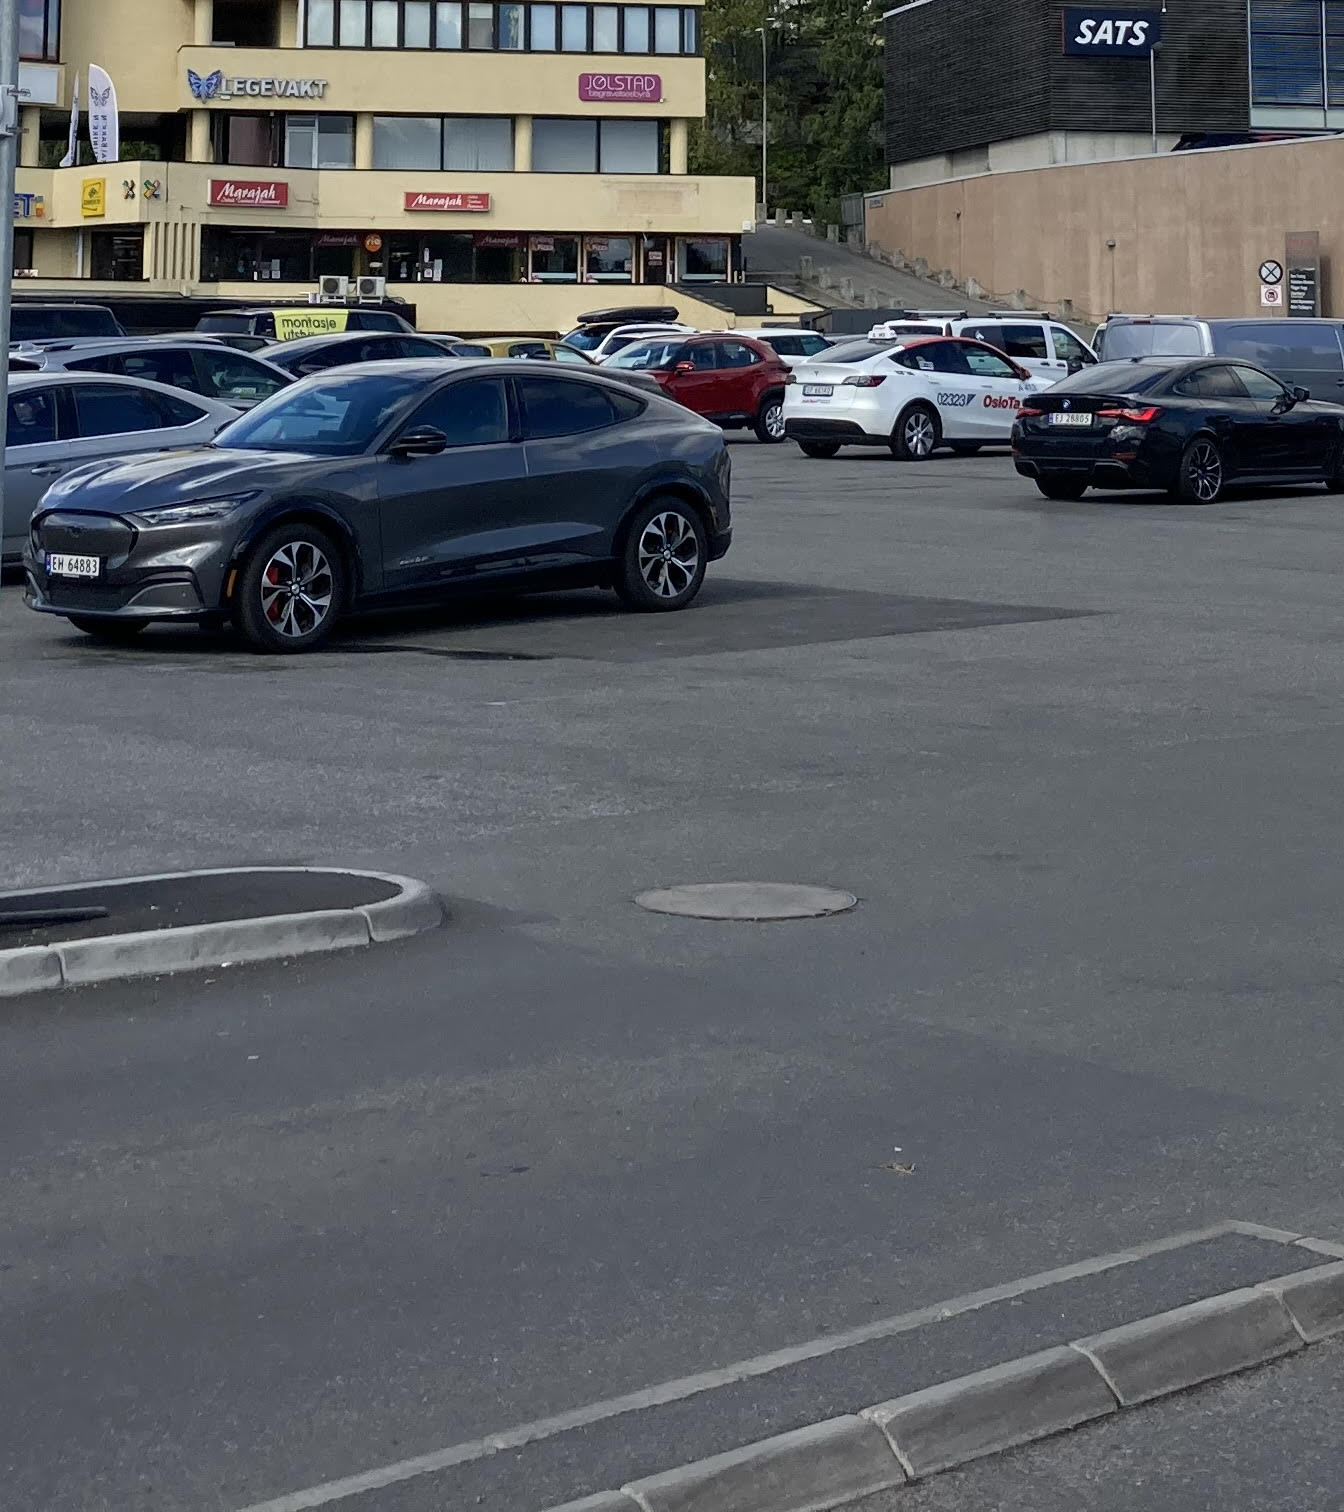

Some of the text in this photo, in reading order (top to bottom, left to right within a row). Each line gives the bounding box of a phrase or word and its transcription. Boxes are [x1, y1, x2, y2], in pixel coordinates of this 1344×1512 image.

[1075, 19, 1149, 46] SATS
[221, 78, 327, 98] LEGEVAKT
[584, 75, 656, 91] JØLSTAD
[412, 194, 462, 209] Marajah
[281, 316, 337, 332] montasje
[937, 393, 966, 407] 02323
[983, 395, 1021, 409] OsloTa
[53, 557, 98, 574] EH 64883
